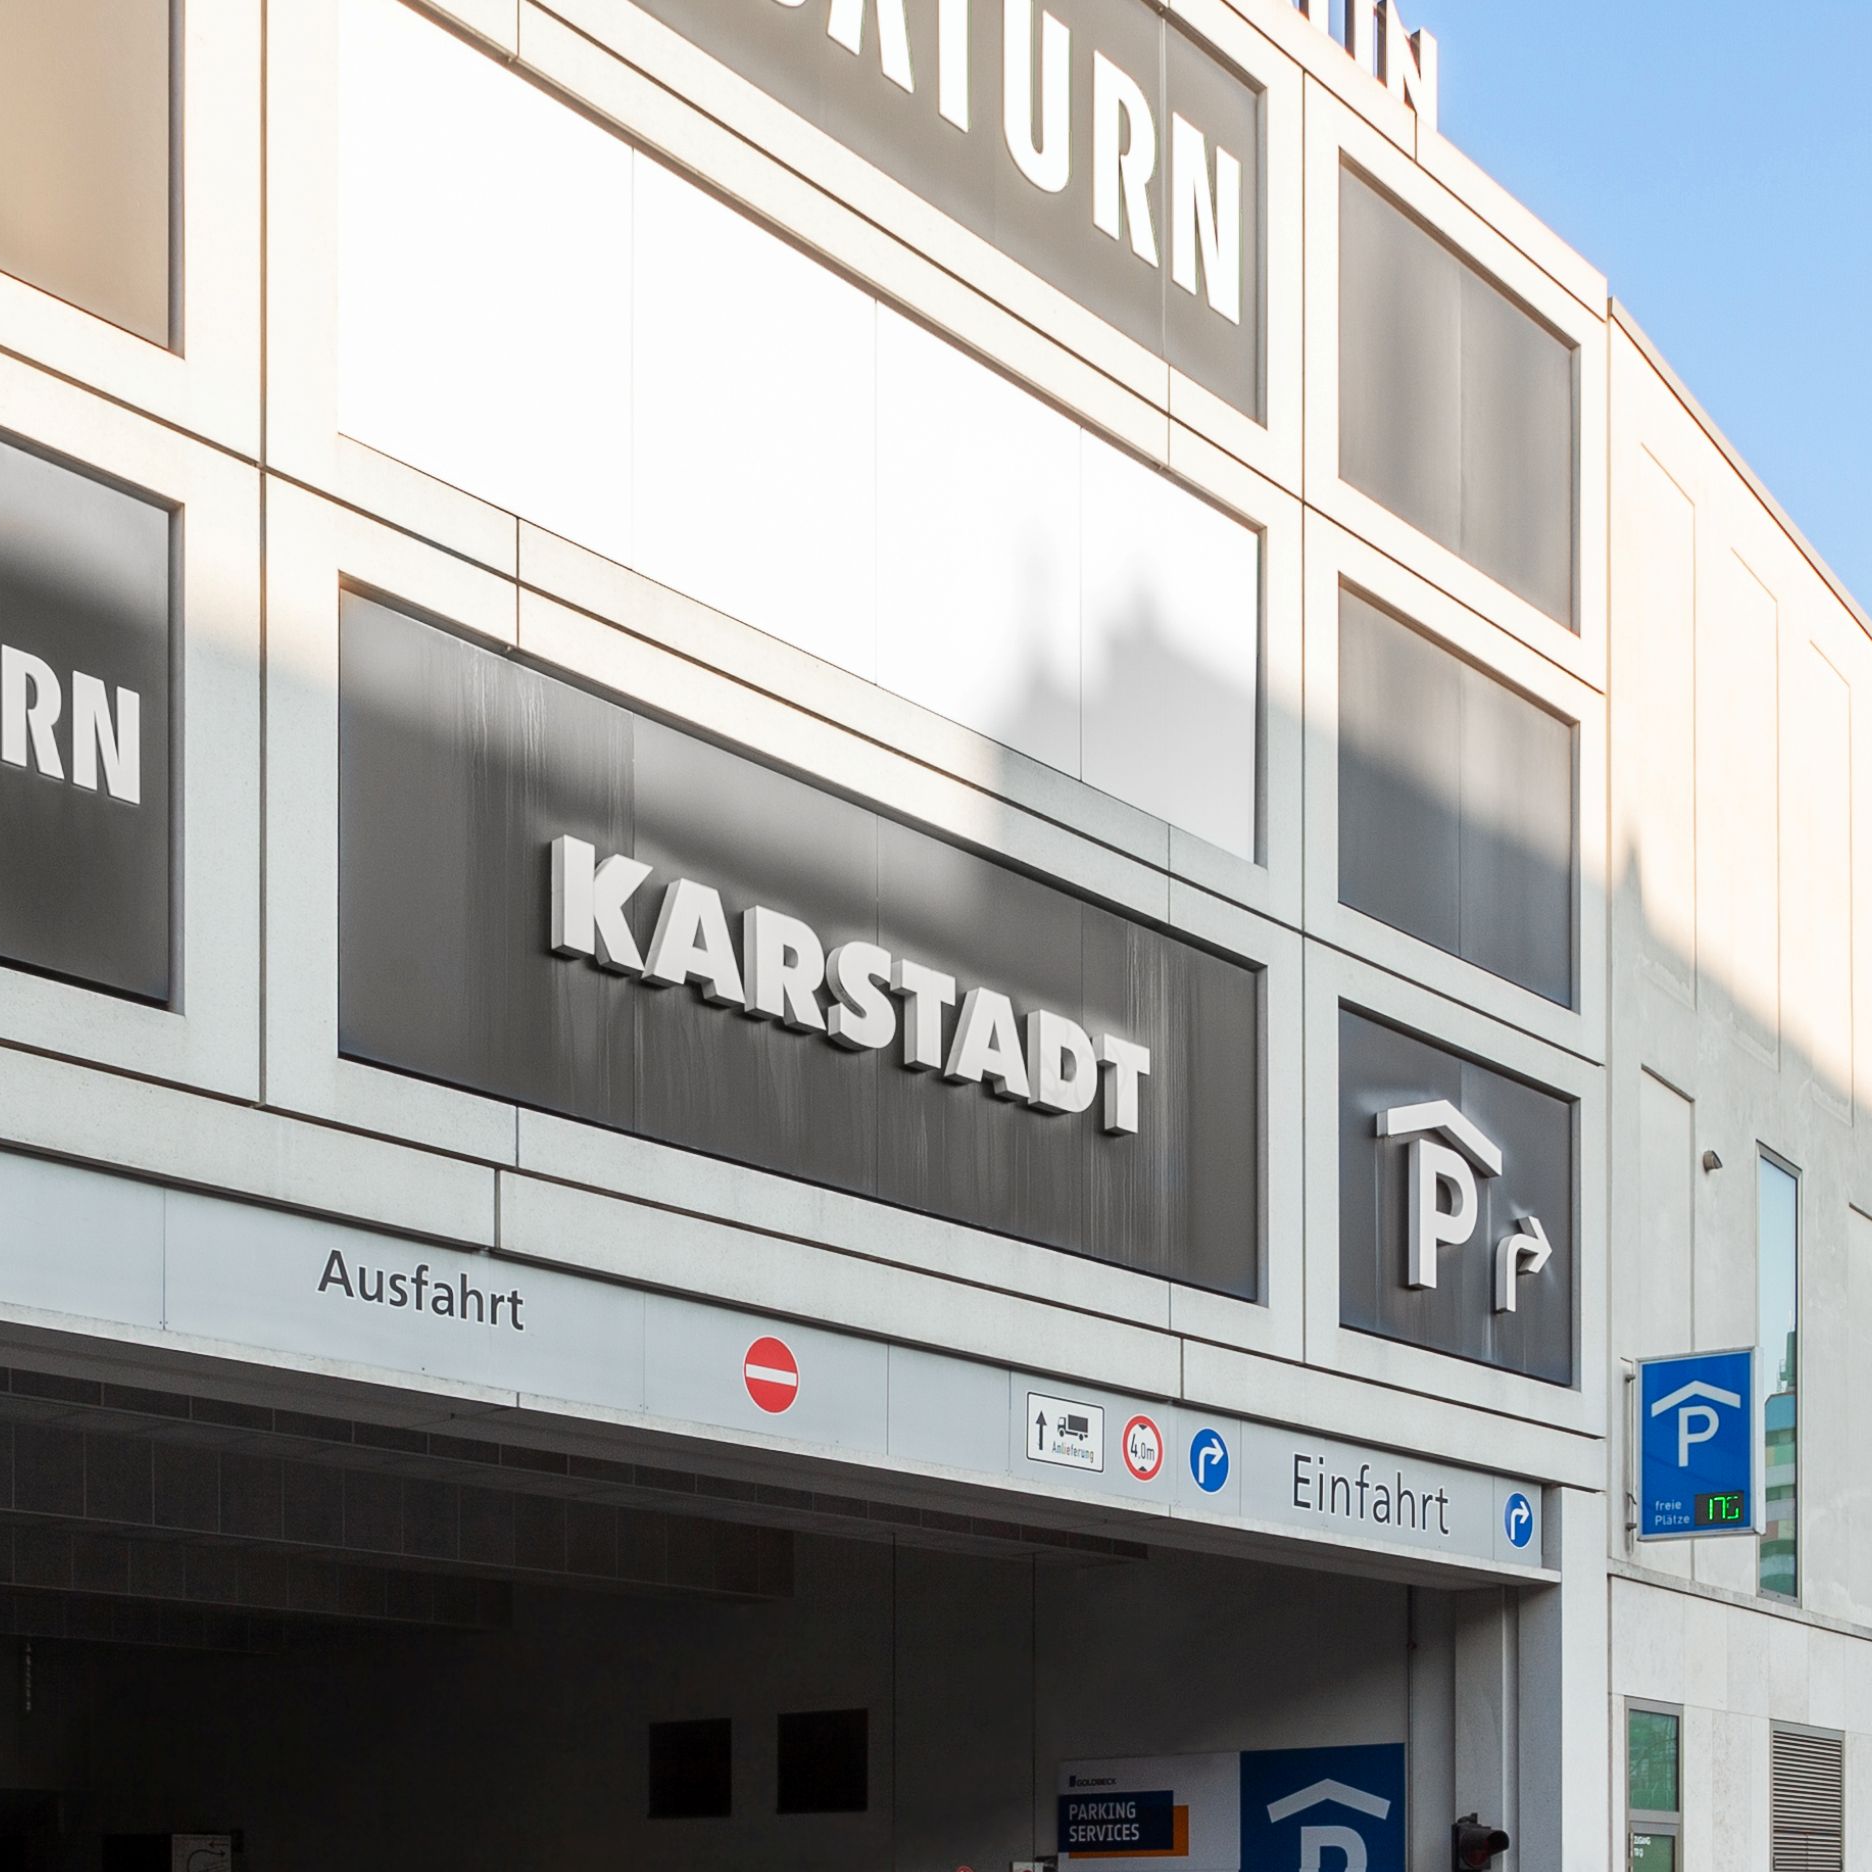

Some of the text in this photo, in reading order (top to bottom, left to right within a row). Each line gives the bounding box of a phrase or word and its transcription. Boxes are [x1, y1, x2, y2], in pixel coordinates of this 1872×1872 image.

[770, 0, 1241, 326] TURN
[550, 834, 1150, 1135] KARSTADT
[1409, 1139, 1477, 1288] P
[317, 1249, 524, 1331] Ausfahrt
[1052, 1441, 1094, 1463] Anlieferung
[1679, 1405, 1719, 1467] P
[1293, 1454, 1449, 1534] Einfahrt
[1655, 1500, 1682, 1510] freie
[1655, 1514, 1690, 1526] Plätze
[1076, 1778, 1117, 1787] GOLDBECK
[1069, 1802, 1136, 1820] PARKING
[1069, 1824, 1140, 1842] SERVICES
